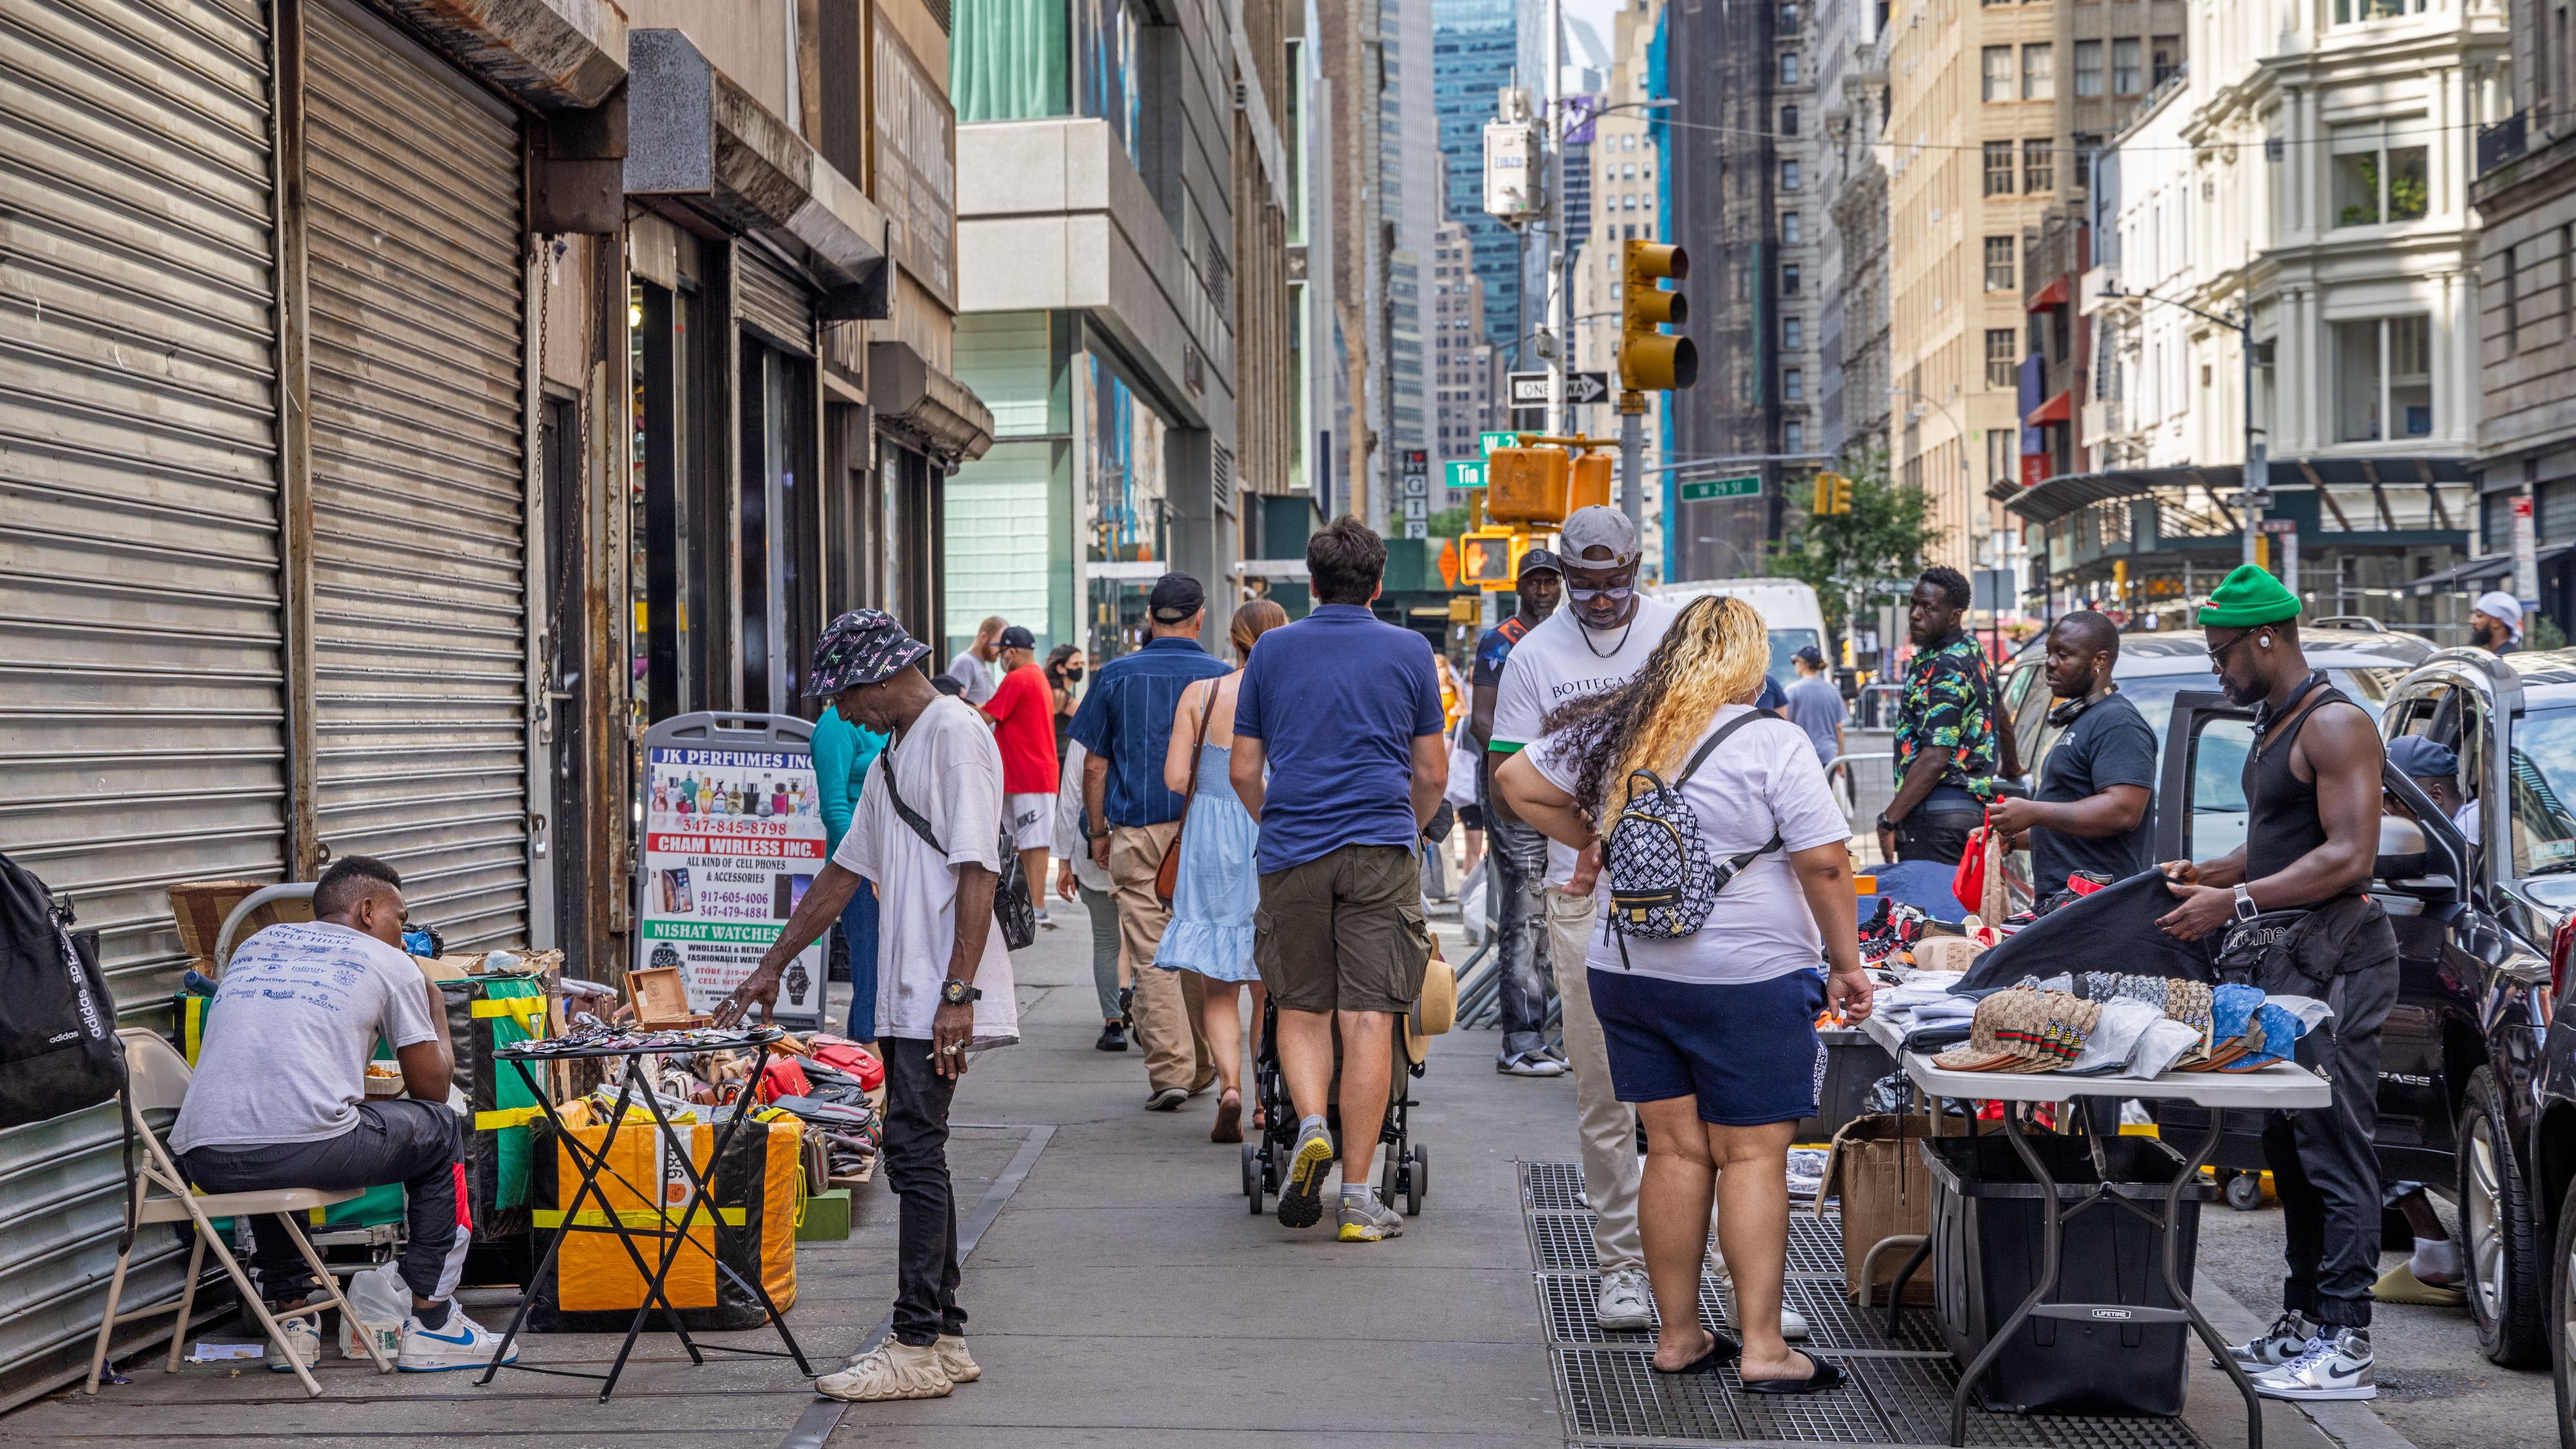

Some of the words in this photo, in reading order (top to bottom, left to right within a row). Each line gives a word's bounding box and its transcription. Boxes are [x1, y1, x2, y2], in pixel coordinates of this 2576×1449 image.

[1567, 383, 1593, 395] WAY
[1457, 464, 1479, 484] Tin
[1699, 485, 1709, 496] W
[1714, 482, 1727, 495] 29
[1553, 676, 1625, 698] BOTTEGA
[661, 748, 682, 764] JK
[687, 750, 782, 768] PERFUMES
[683, 819, 787, 835] 347-845-8798
[658, 837, 705, 853] CHAM
[709, 838, 781, 856] WIRLESS
[783, 841, 815, 857] INC.
[687, 857, 700, 867] ALL
[702, 857, 721, 867] KIND
[722, 858, 733, 868] OF
[735, 858, 754, 869] CELL
[755, 859, 786, 870] PHONES
[706, 873, 712, 881] &
[713, 872, 765, 884] ACCESSORIES
[701, 891, 768, 905] 917-605-4006
[700, 905, 768, 918] 347-479-4884
[654, 923, 708, 938] NISHAT
[710, 925, 781, 941] WATCHES
[688, 944, 732, 952] WHOLESALE
[301, 995, 341, 1011] SAXONY
[79, 989, 102, 1038] adidas
[50, 1030, 79, 1044] adidas
